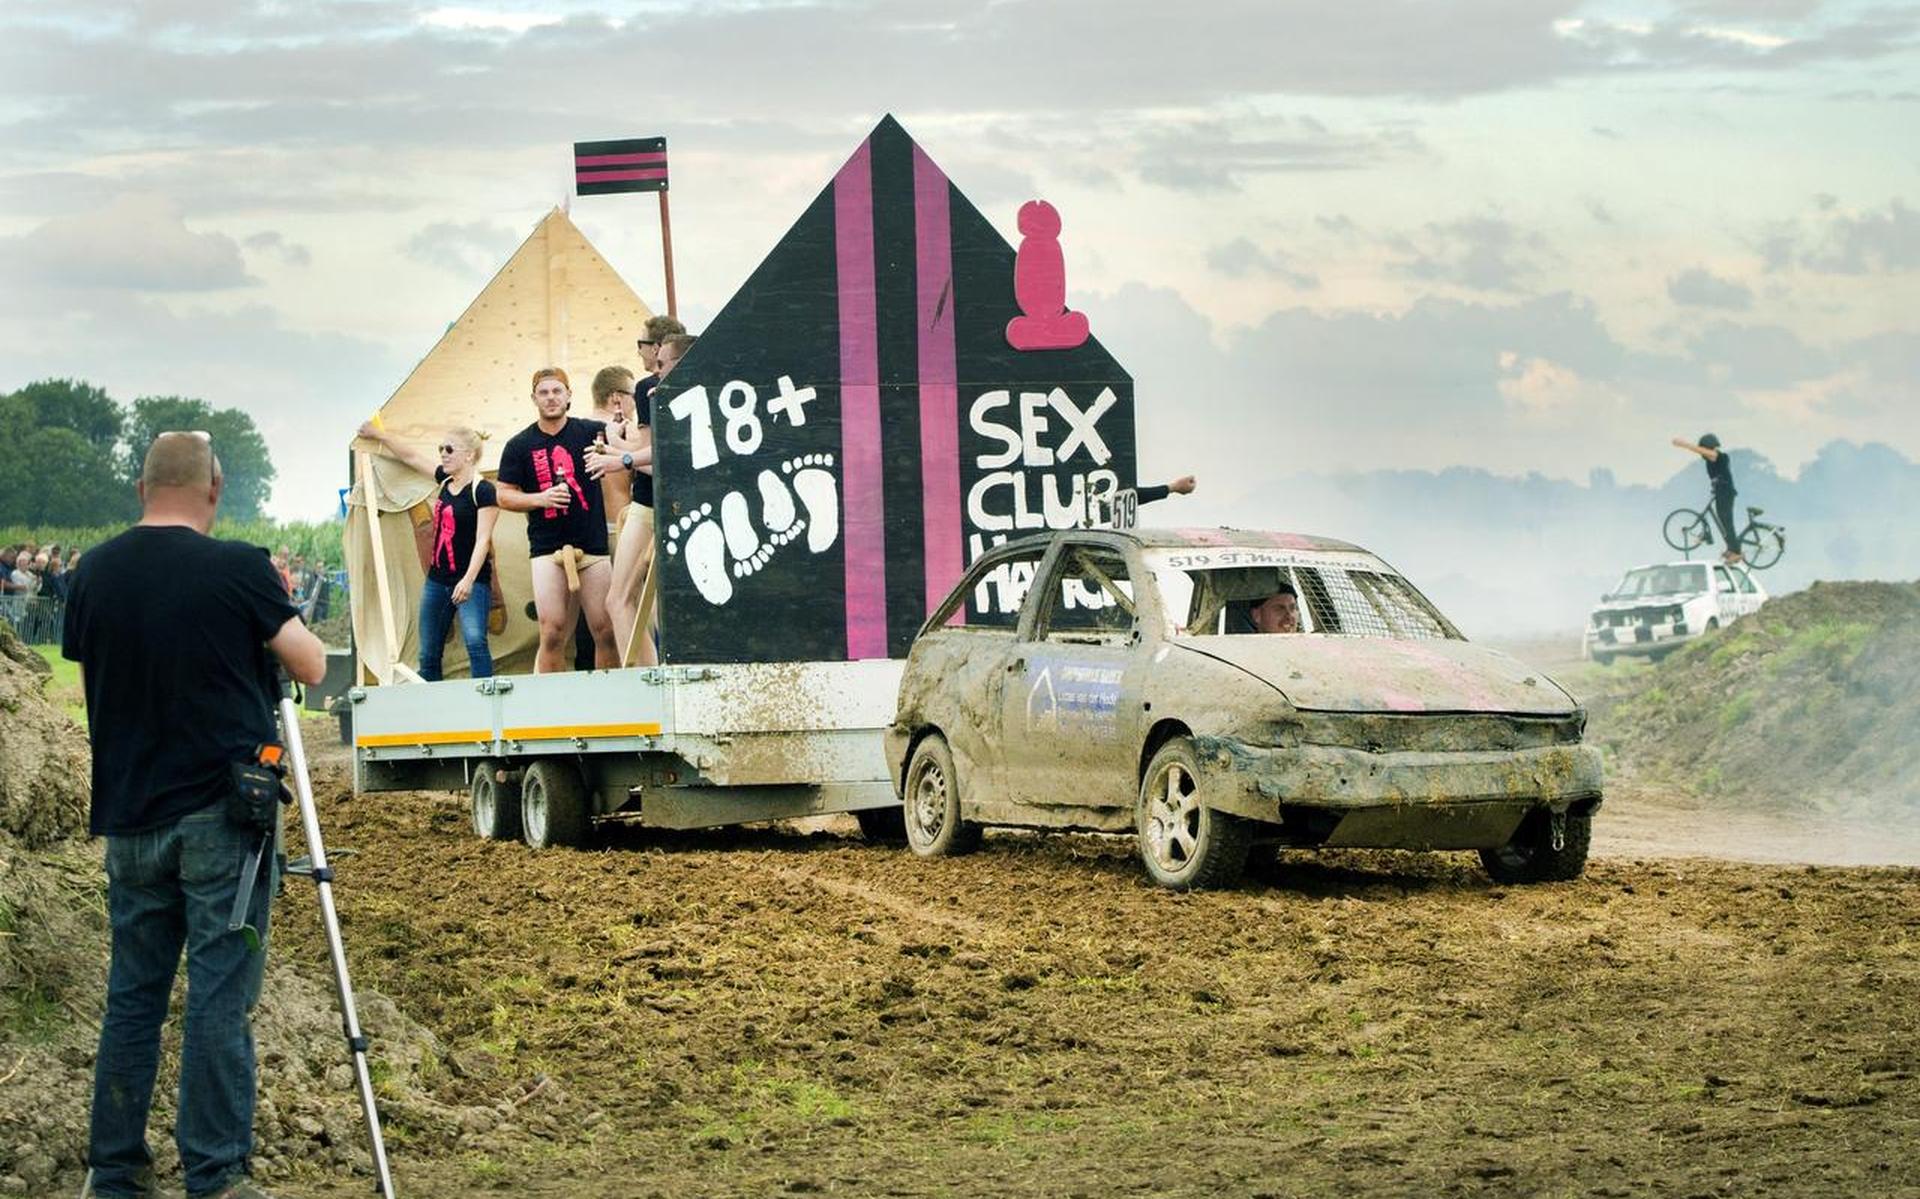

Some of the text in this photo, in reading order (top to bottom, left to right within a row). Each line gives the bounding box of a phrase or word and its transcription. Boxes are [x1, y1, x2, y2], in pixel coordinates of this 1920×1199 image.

[668, 374, 817, 470] 18+
[968, 386, 1118, 470] SEX
[1112, 491, 1136, 529] 519
[1168, 554, 1211, 567] 519
